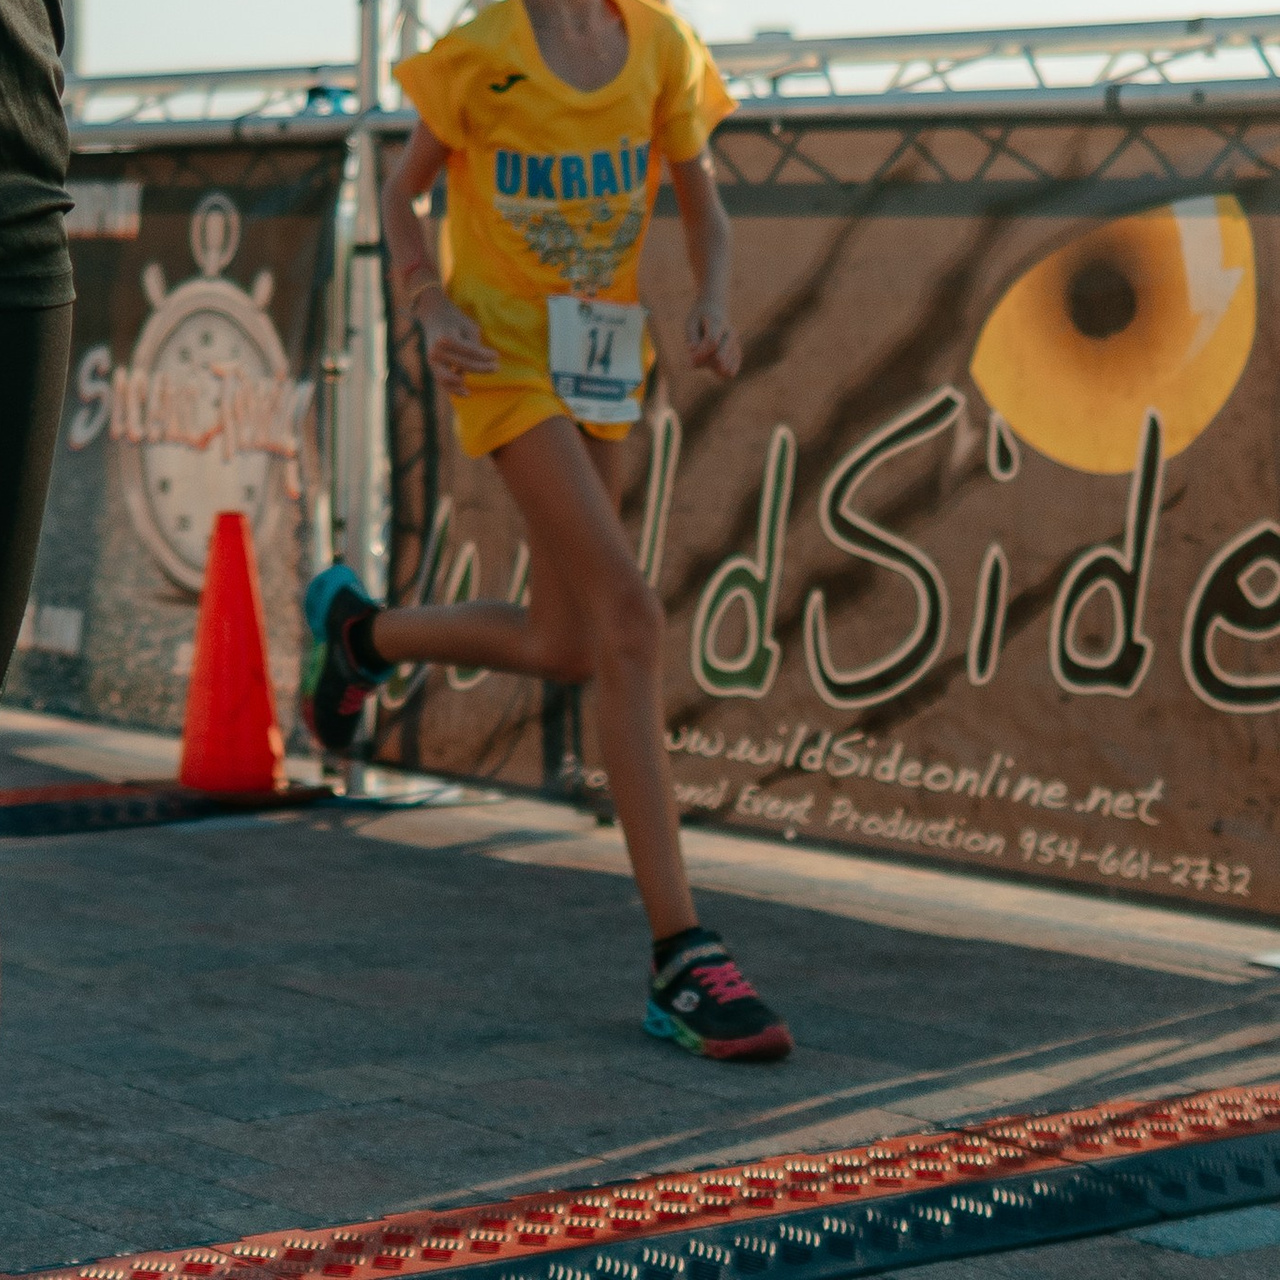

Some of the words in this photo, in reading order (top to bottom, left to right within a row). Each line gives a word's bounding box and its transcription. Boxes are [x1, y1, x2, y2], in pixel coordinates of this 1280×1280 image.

[586, 327, 616, 375] 14
[735, 784, 817, 825] Event
[826, 795, 1008, 857] Production
[1020, 826, 1254, 898] 954-661-2732
